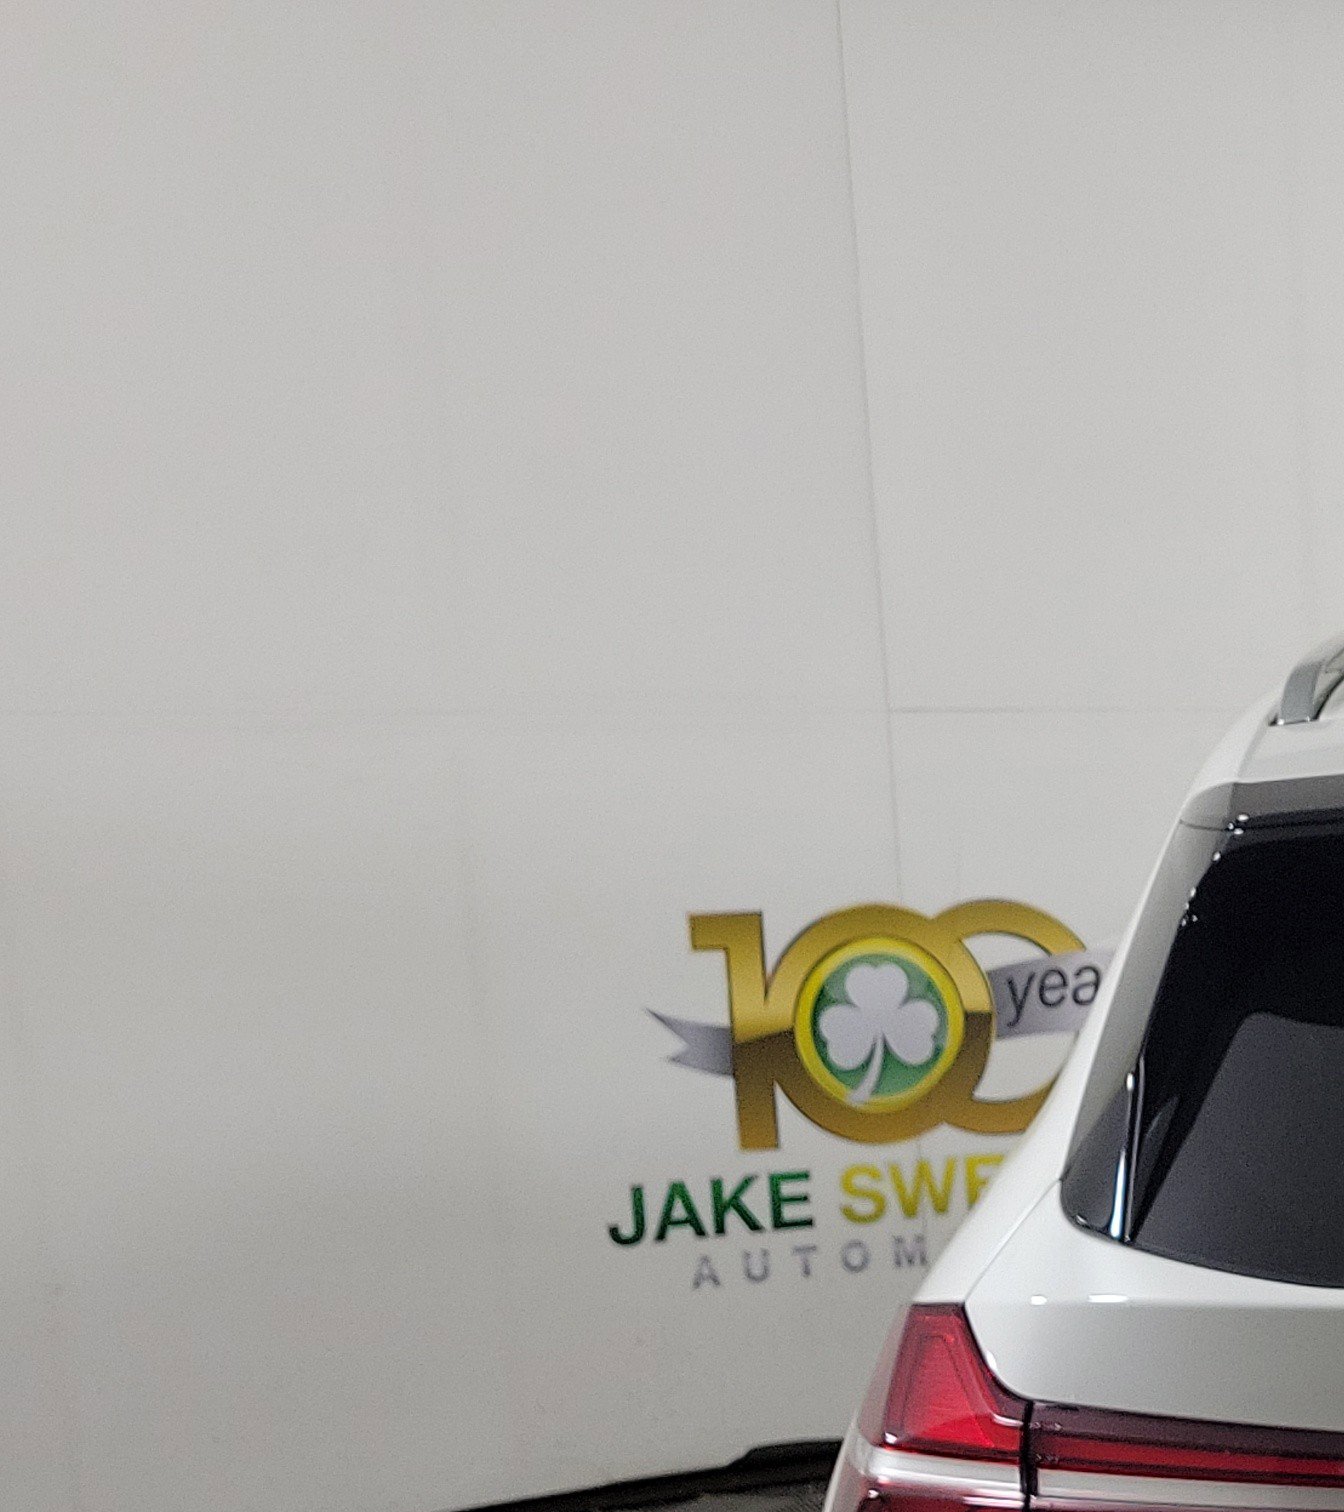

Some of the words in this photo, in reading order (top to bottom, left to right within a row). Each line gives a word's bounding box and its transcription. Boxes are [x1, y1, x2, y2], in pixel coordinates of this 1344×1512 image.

[687, 899, 1088, 1152] 100
[1006, 965, 1101, 1028] yea
[608, 1169, 814, 1247] JAKE
[692, 1232, 930, 1290] AUTOM
